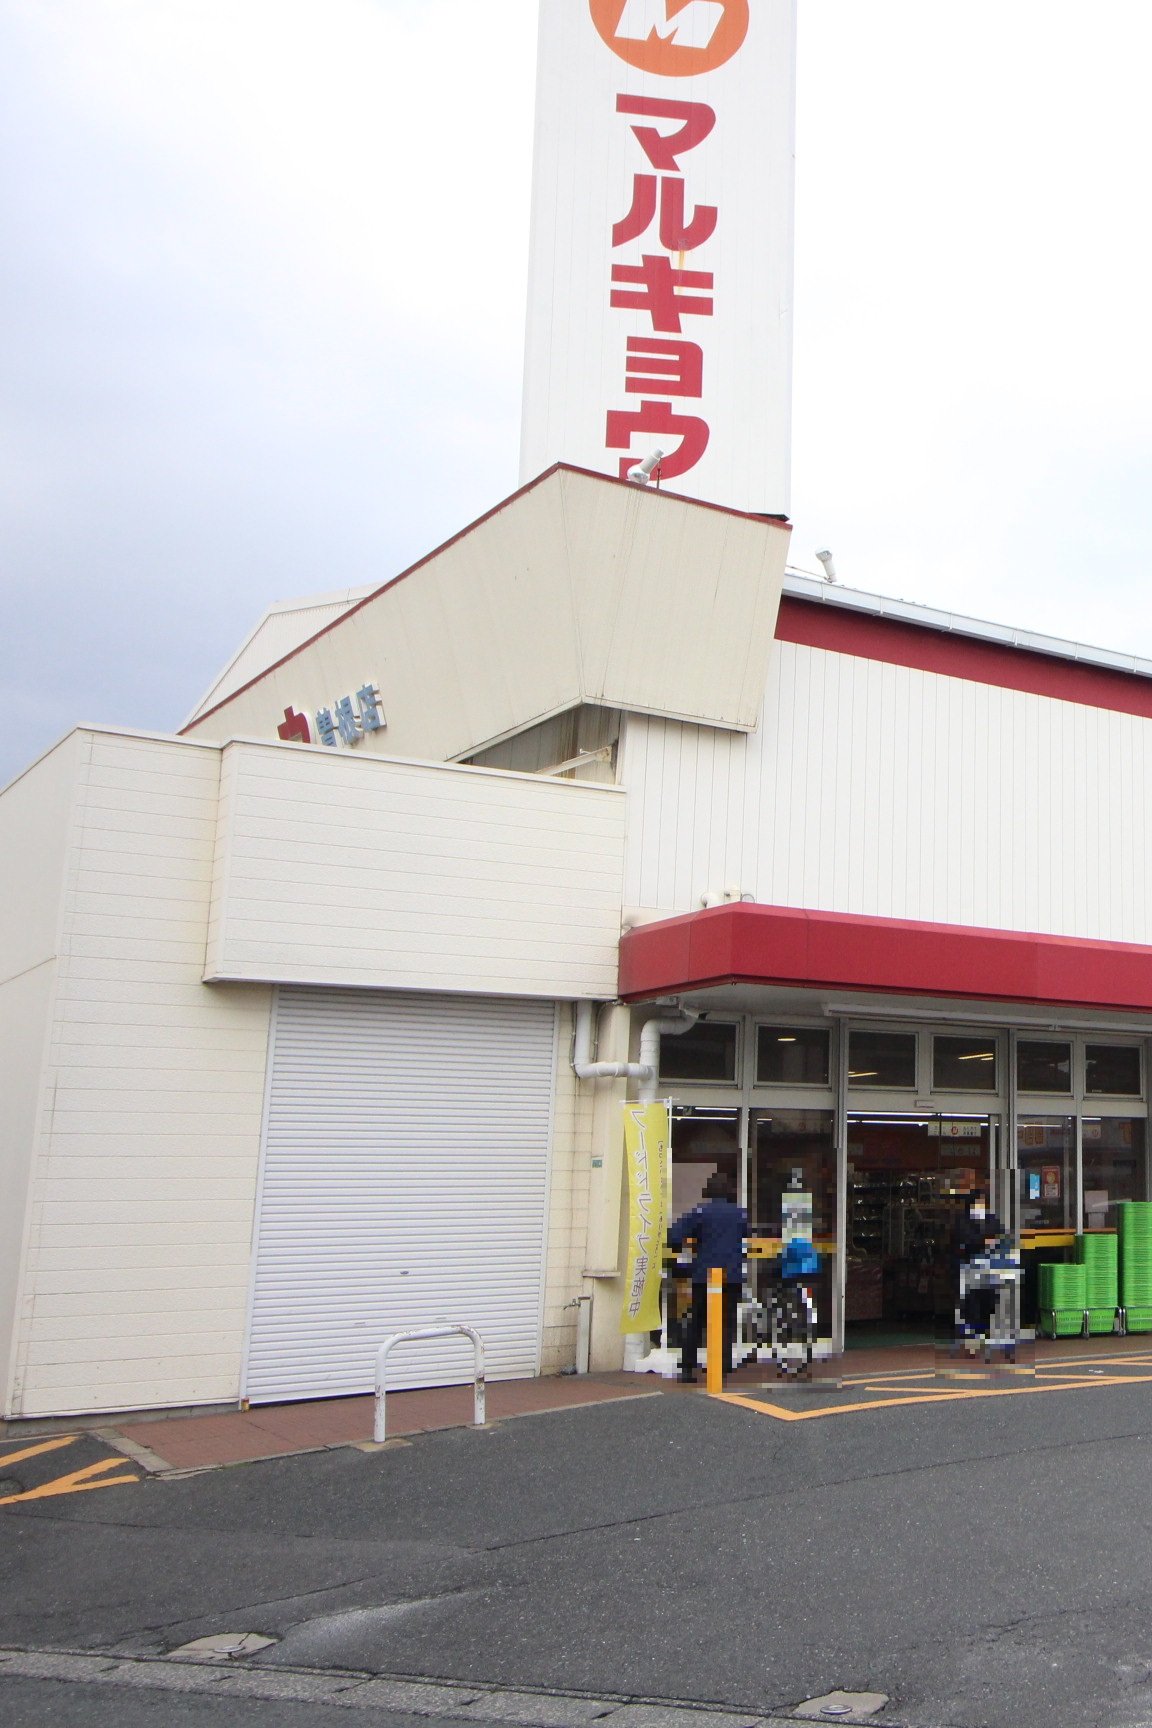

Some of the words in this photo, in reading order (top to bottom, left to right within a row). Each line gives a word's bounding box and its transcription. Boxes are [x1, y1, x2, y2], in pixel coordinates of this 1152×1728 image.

[606, 93, 718, 481] マルキョウ
